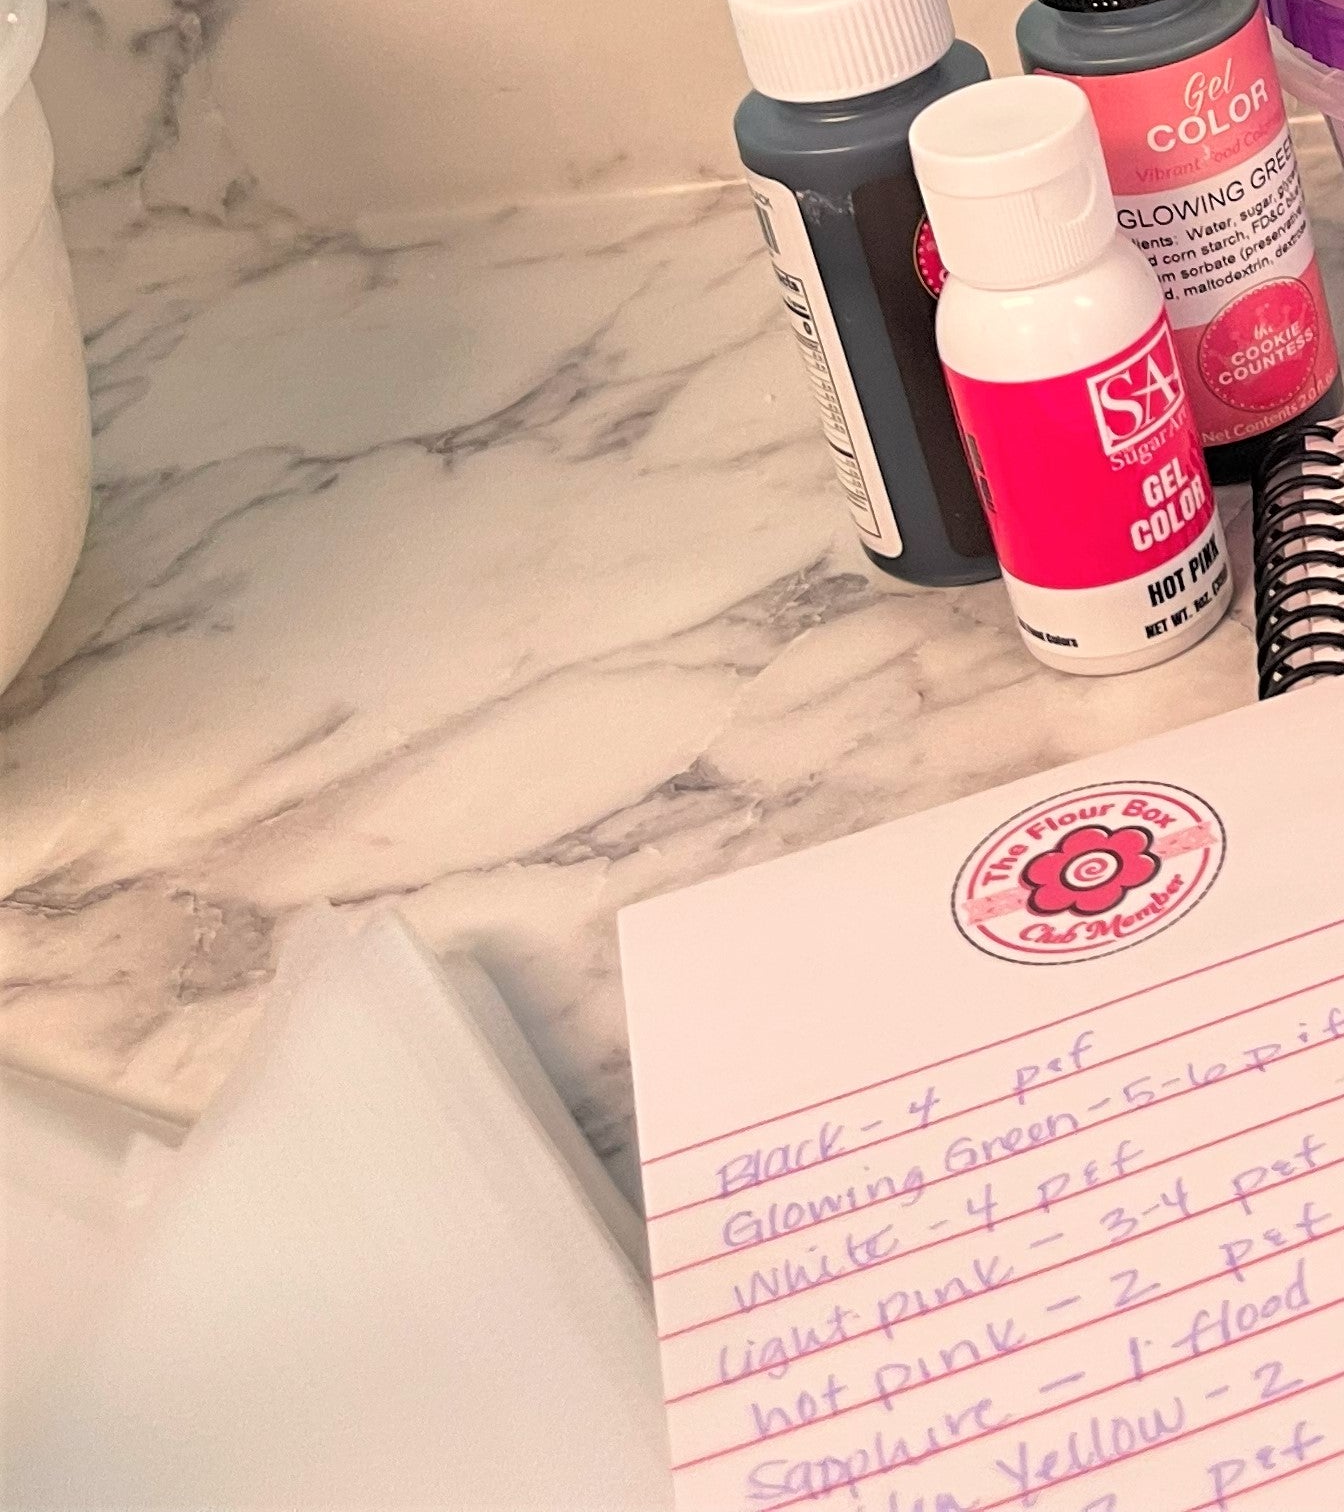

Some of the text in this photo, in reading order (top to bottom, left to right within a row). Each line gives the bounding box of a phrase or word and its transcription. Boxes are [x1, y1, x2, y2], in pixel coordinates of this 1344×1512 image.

[1146, 78, 1269, 152] COLOR
[1184, 57, 1235, 116] Gel
[1117, 179, 1245, 229] GLOWING
[1250, 134, 1293, 190] GREE
[1162, 248, 1197, 265] corn
[1200, 230, 1250, 256] starch,
[1185, 217, 1237, 241] Water,
[1239, 194, 1277, 222] sugar,
[1180, 252, 1237, 280] sorbate
[1218, 327, 1314, 386] COUNTESS
[1231, 321, 1301, 366] COOKIE
[1109, 428, 1168, 472] Sugar
[1234, 403, 1298, 437] Contents
[1142, 457, 1189, 508] GEL
[1147, 567, 1186, 608] HOT
[1188, 533, 1220, 583] PINK
[1145, 616, 1169, 639] NET
[982, 798, 1178, 887] The Flour Box
[1086, 872, 1186, 941] Member
[715, 1121, 846, 1199] Black
[908, 1086, 942, 1130] 4
[721, 1164, 928, 1248] Glowing
[944, 1111, 1081, 1174] Green
[733, 1222, 900, 1313] White
[965, 1182, 1000, 1233] 4
[877, 1255, 1015, 1340] pink
[1099, 1175, 1193, 1244] 3-4
[1170, 1257, 1312, 1356] flood
[750, 1372, 849, 1441] hot
[874, 1318, 1028, 1412] pink
[1109, 1268, 1162, 1309] 2
[995, 1396, 1186, 1509] Yellow
[1253, 1360, 1305, 1400] 2
